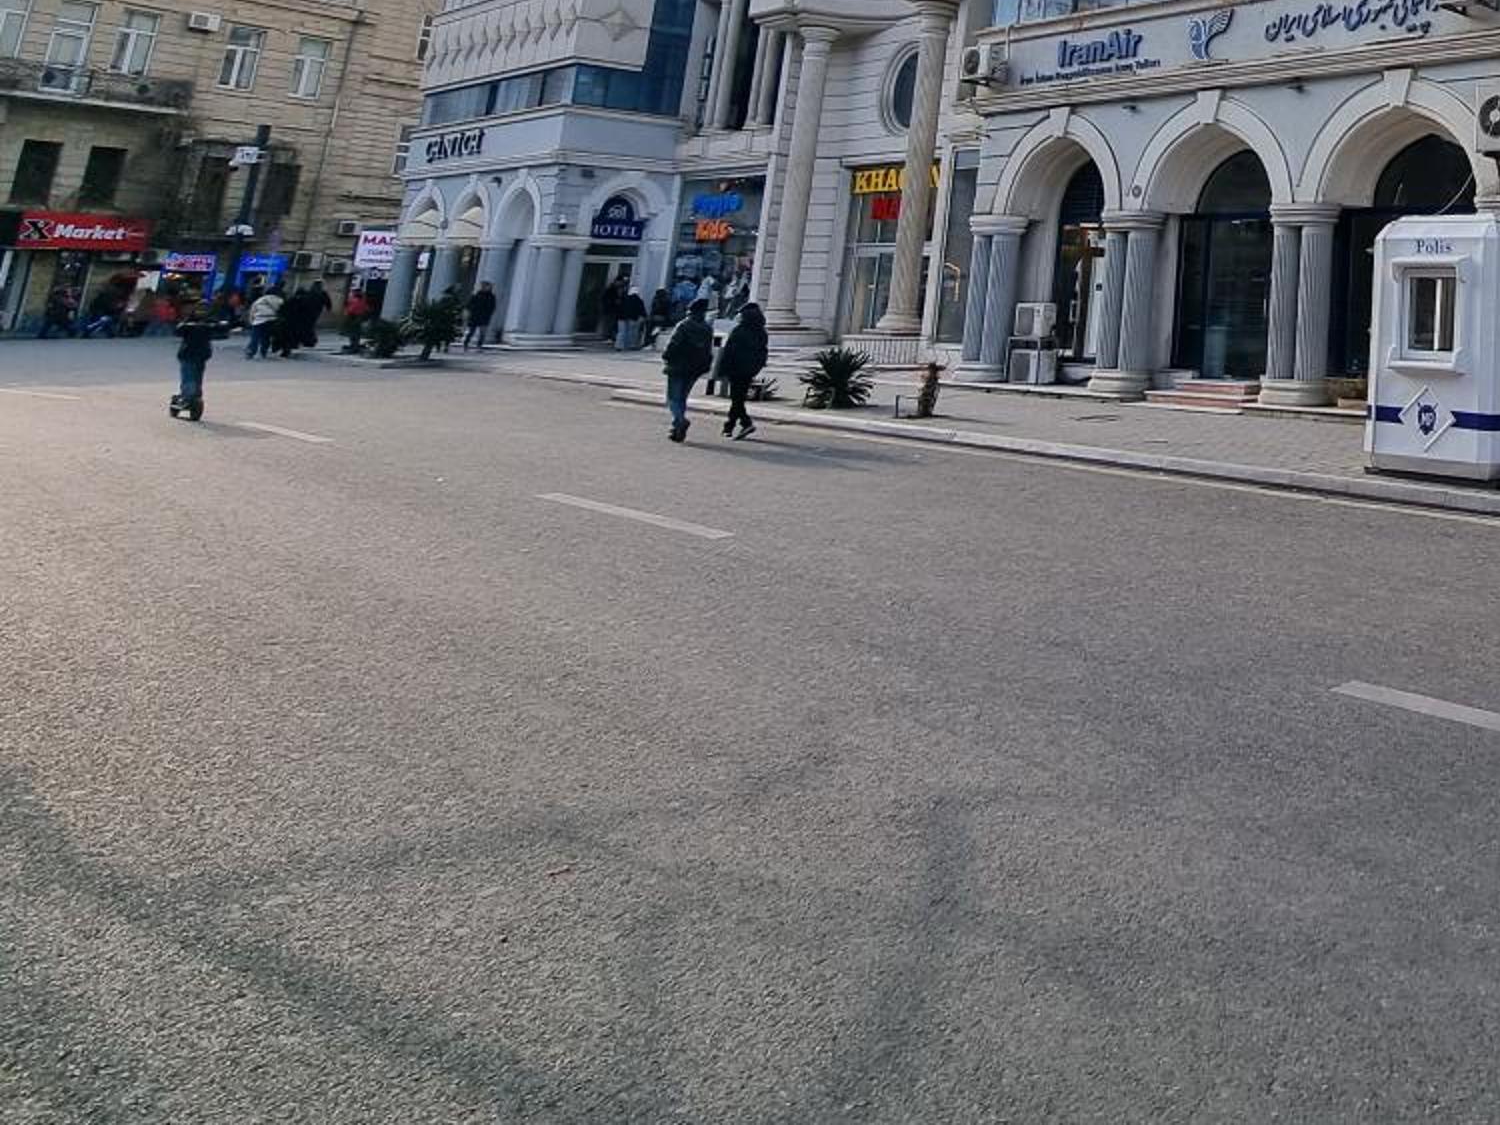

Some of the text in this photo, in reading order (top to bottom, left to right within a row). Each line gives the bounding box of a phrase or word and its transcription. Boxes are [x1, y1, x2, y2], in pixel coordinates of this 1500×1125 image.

[1058, 28, 1143, 68] IranAir
[53, 224, 127, 240] Market
[1415, 238, 1454, 255] Polis
